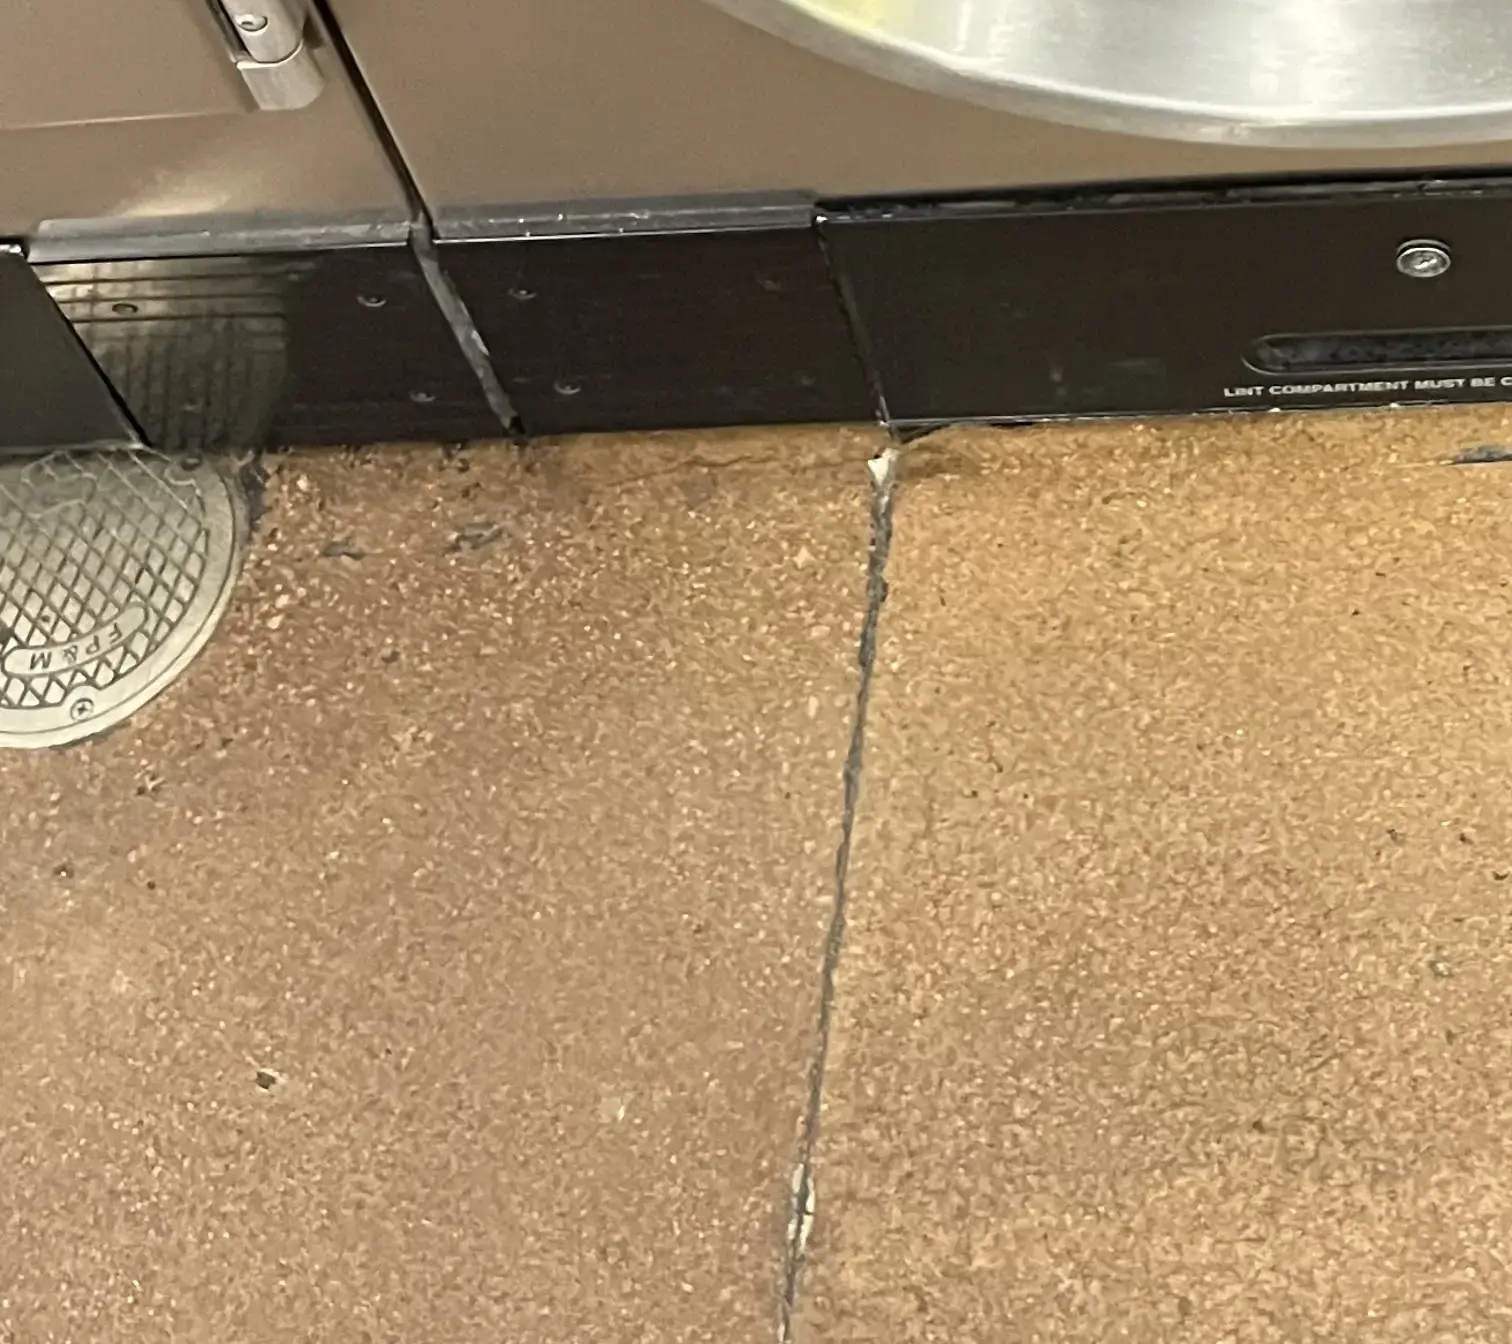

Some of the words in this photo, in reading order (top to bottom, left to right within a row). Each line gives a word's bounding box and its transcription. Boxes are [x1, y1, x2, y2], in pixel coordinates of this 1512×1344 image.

[1223, 386, 1264, 397] LINT
[1268, 380, 1409, 395] COMPARTMENT
[1414, 378, 1465, 390] MUST
[1470, 377, 1495, 387] BE
